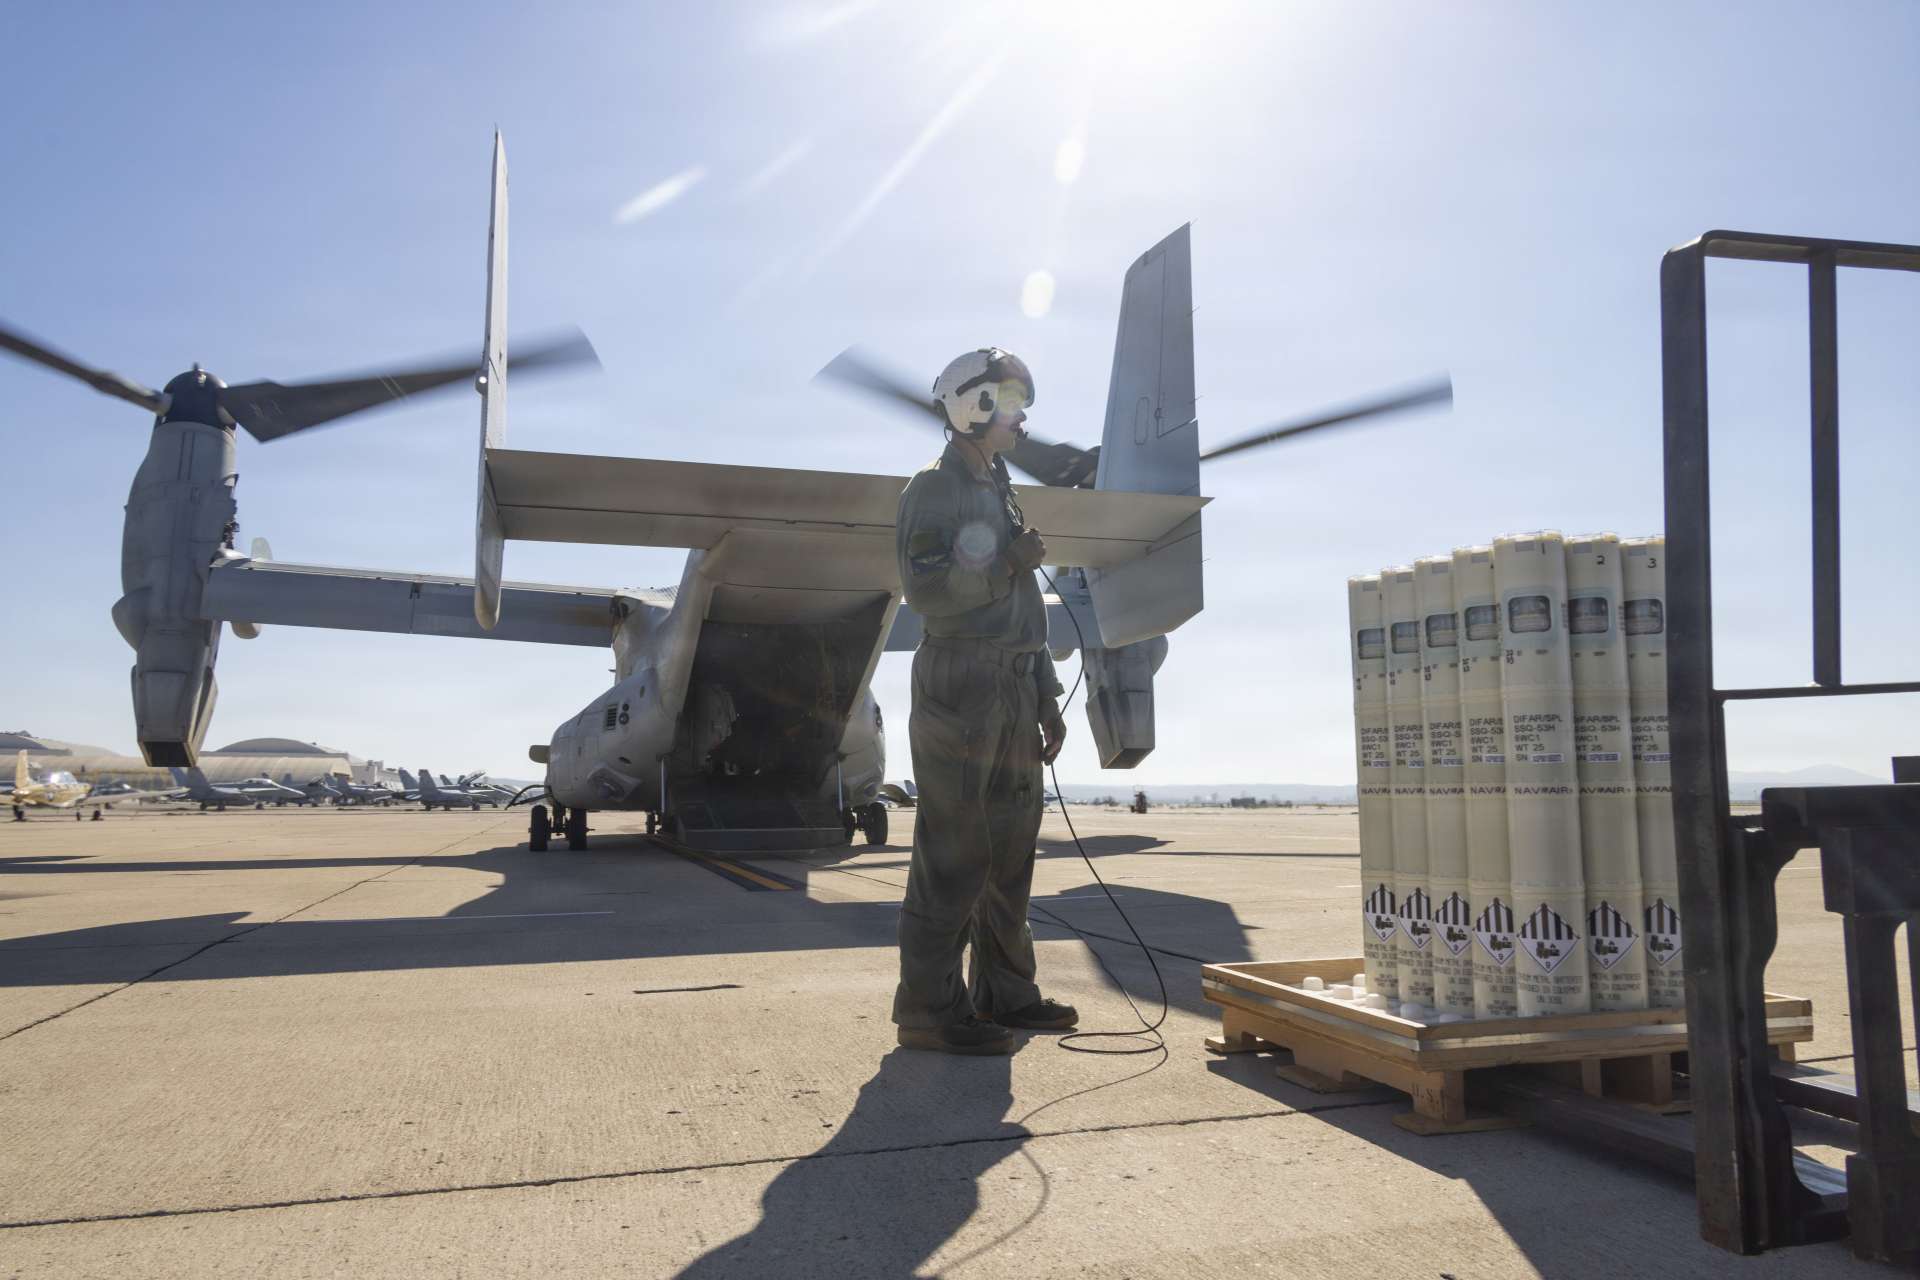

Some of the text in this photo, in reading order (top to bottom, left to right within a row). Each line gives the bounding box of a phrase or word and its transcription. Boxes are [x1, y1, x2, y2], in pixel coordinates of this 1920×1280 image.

[1596, 555, 1606, 565] 2
[1647, 558, 1657, 568] 3
[1515, 743, 1545, 752] WT 25
[1591, 744, 1603, 752] 25
[1516, 753, 1528, 762] SN
